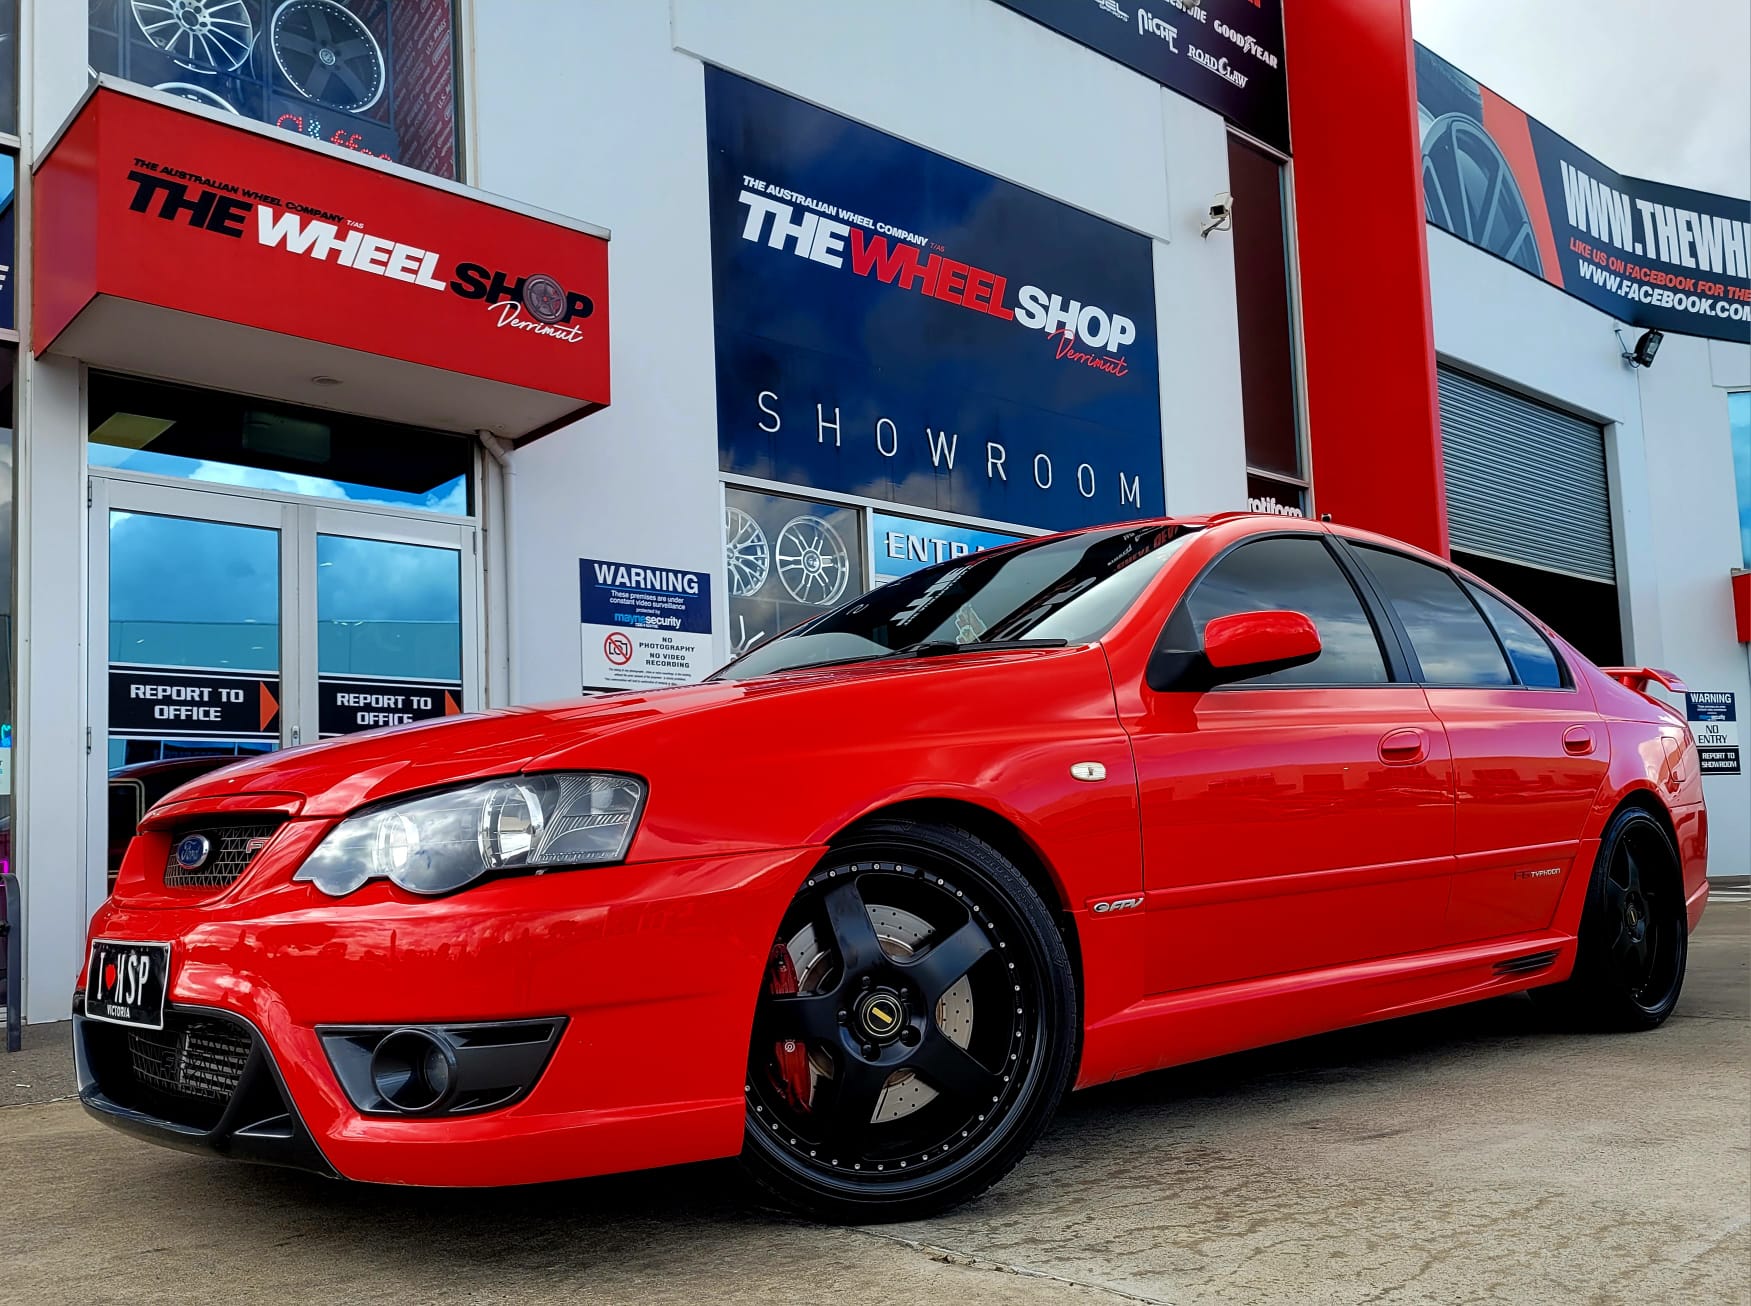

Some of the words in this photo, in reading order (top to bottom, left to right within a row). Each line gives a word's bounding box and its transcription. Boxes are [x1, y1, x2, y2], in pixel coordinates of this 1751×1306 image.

[1213, 19, 1278, 69] GOODYEAR
[134, 158, 157, 171] THE
[161, 166, 239, 195] AUSTRALIAN
[242, 189, 282, 207] WHEEL
[286, 202, 344, 223] COMPANY
[347, 219, 364, 229] T/AS
[743, 175, 766, 192] THE
[766, 184, 837, 217] AUSTRALIAN
[839, 208, 875, 230] WHEEL
[876, 222, 929, 247] COMPANY
[127, 170, 253, 238] THE
[257, 205, 446, 291] WHEEL
[738, 190, 851, 269] THE
[850, 227, 1014, 321] WHEEL
[1014, 285, 1136, 353] SHOP
[1570, 236, 1591, 258] LIKE
[1592, 249, 1607, 266] US
[1609, 256, 1625, 273] ON
[1626, 263, 1696, 292] FACEBOOK
[1697, 281, 1724, 297] FOR
[1728, 286, 1750, 301] THE
[488, 301, 584, 343] Derrimut
[1048, 328, 1128, 377] Derrimut
[758, 390, 1141, 509] SHOWROOM
[887, 531, 985, 564] ENTR
[594, 563, 699, 594] WARNING
[610, 597, 635, 605] constant
[653, 601, 686, 610] surveillance
[611, 590, 629, 598] These
[630, 592, 656, 602] premises
[639, 642, 695, 652] PHOTOGRAPHY
[645, 659, 690, 668] RECORDING
[130, 684, 212, 701] REPORT
[217, 689, 244, 703] TO
[336, 693, 405, 708] REPORT
[410, 696, 432, 709] TO
[1690, 693, 1732, 704] WARNING
[154, 705, 222, 721] OFFICE
[1706, 725, 1719, 734] NO
[1698, 734, 1727, 744] ENTRY
[1701, 760, 1737, 768] SHOWROOM
[1702, 752, 1725, 760] REPORT
[106, 1004, 131, 1018] VICTORIA
